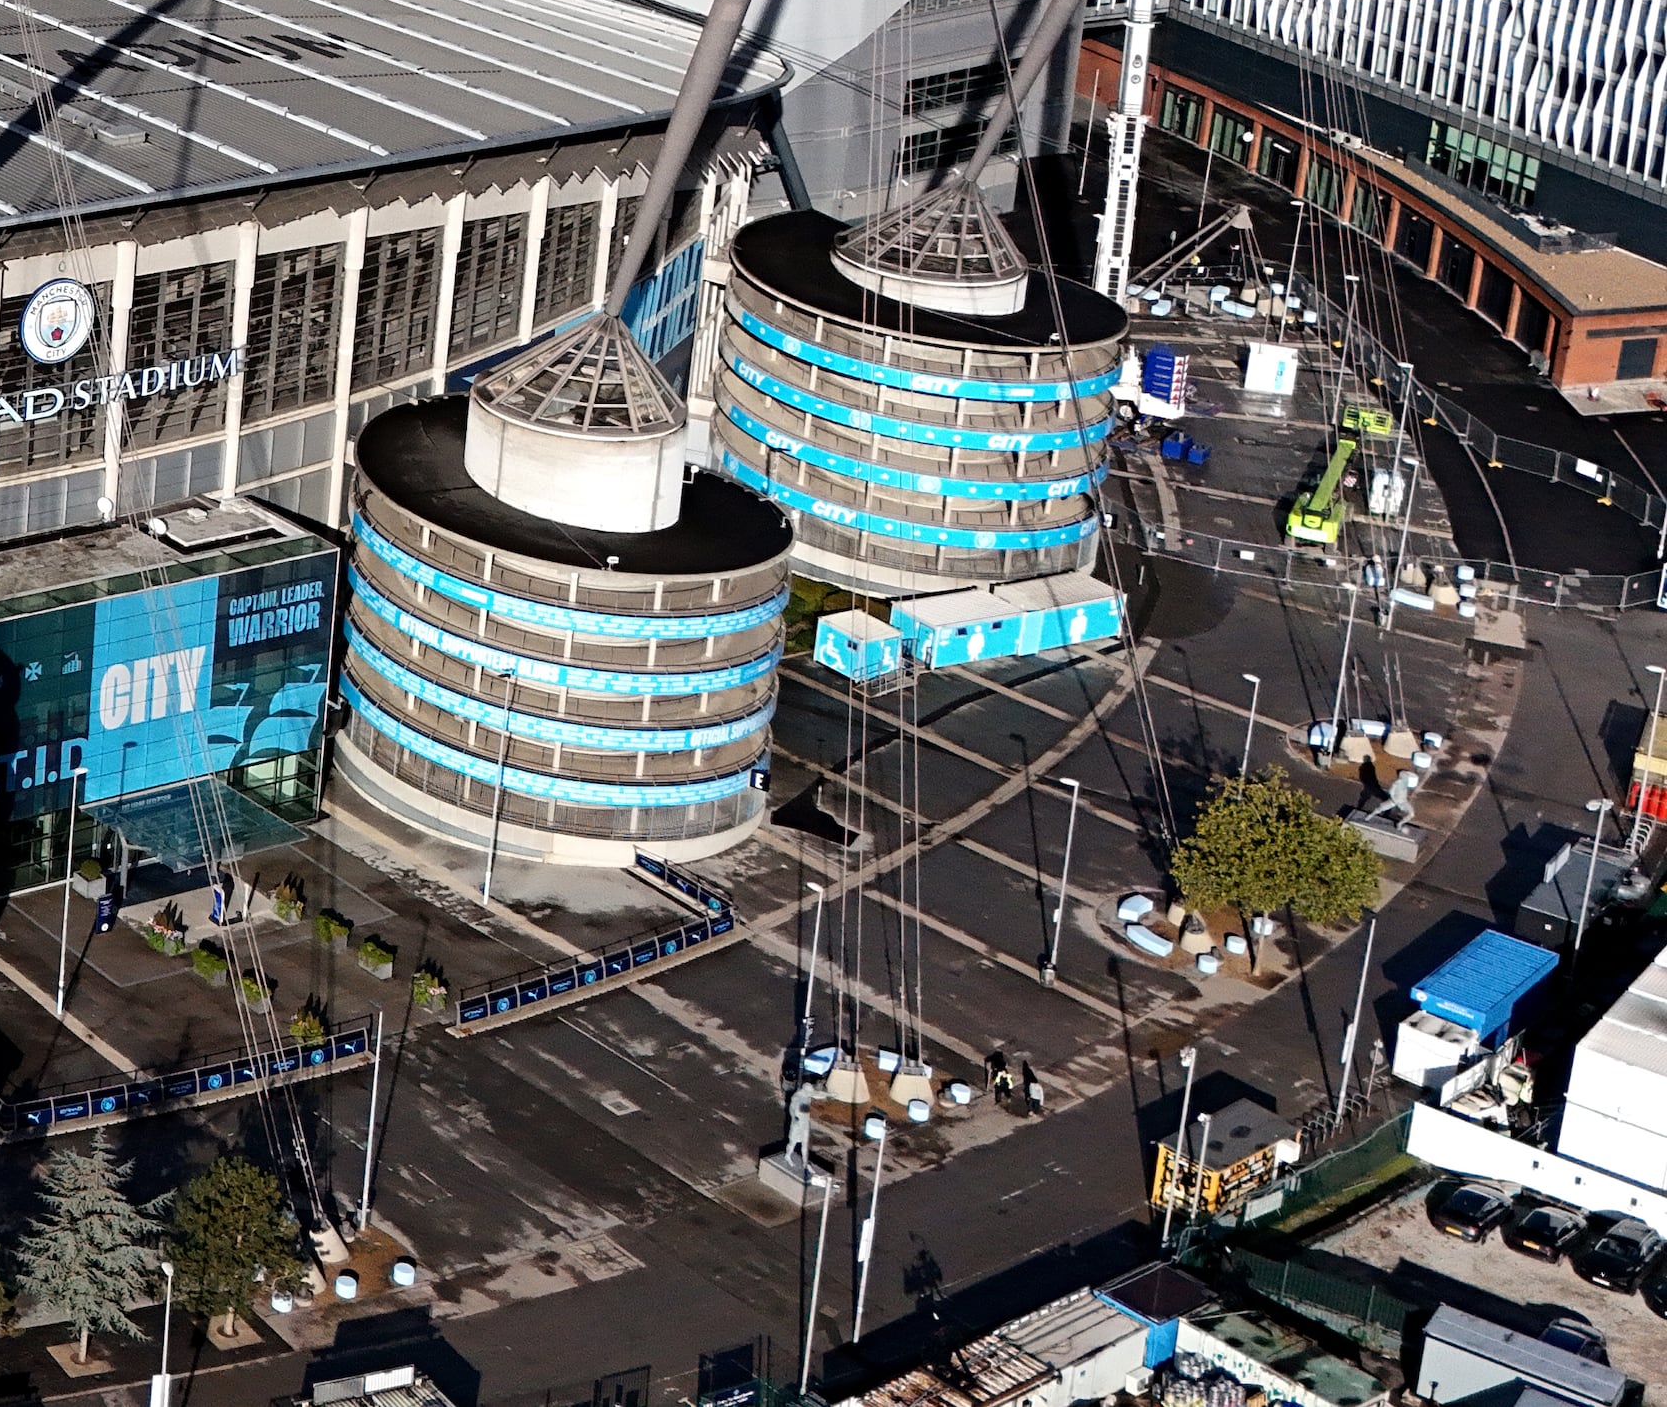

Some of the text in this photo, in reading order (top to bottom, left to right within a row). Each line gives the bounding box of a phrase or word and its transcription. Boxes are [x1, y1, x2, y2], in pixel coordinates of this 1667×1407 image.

[46, 348, 67, 359] CITY
[73, 349, 239, 410] STADIUM
[739, 362, 765, 386] CITY
[911, 376, 963, 395] CITY
[767, 431, 803, 456] CITY
[987, 434, 1034, 451] CITY
[1048, 478, 1081, 497] CITY
[812, 500, 857, 524] CITY
[229, 592, 278, 616] CAPTAIN,
[228, 601, 321, 647] WARRIOR
[100, 647, 207, 731] CITY
[755, 772, 764, 784] E
